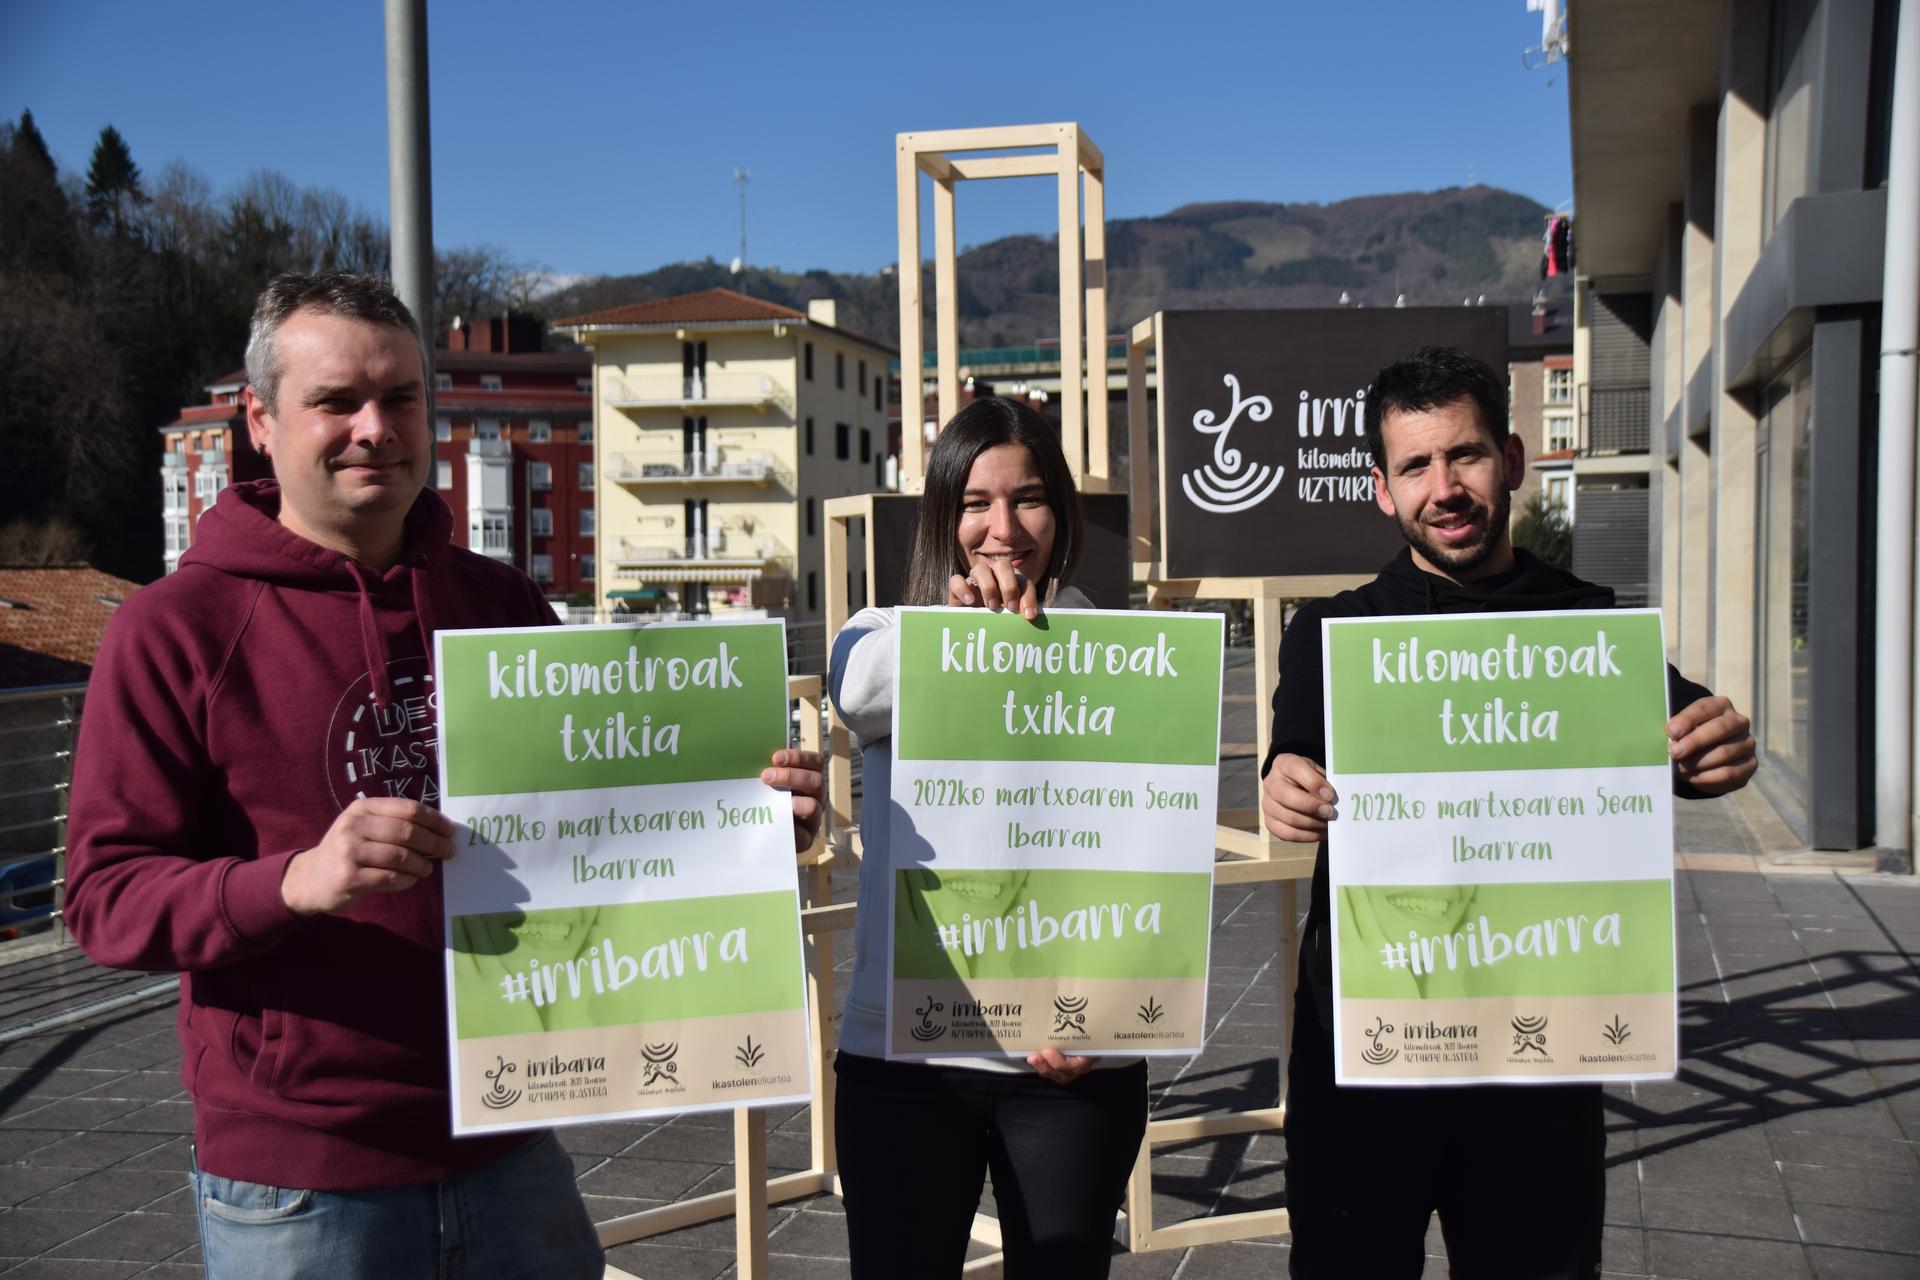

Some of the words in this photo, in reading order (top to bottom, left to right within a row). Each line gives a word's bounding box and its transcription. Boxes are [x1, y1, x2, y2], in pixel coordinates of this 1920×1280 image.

[1298, 384, 1372, 438] irri
[488, 641, 743, 700] kilometroak
[941, 626, 1178, 679] kilometroak
[1371, 629, 1622, 685] kilometroak
[560, 711, 680, 763] txikia
[1001, 689, 1116, 737] txikia
[1438, 696, 1560, 746] txikia
[913, 778, 986, 808] 2022ko
[996, 779, 1135, 809] martxoaren
[1145, 781, 1200, 811] 5ean
[1350, 791, 1427, 822] 2022ko
[1437, 789, 1585, 820] martxoaren
[1596, 786, 1654, 815] 5ean
[466, 815, 546, 847] 2022ko
[558, 812, 705, 840] martxoaren
[716, 798, 774, 829] 5ean
[1006, 821, 1102, 850] Ibarran
[572, 852, 676, 885] Ibarran
[1452, 835, 1553, 865] Ibarran
[937, 899, 1162, 957] #irribarra
[1379, 911, 1622, 977] #irribarra
[500, 926, 750, 1008] #irribarra
[951, 999, 1023, 1017] irribarra
[1403, 1020, 1479, 1040] irribarra
[527, 1054, 606, 1078] irribarra
